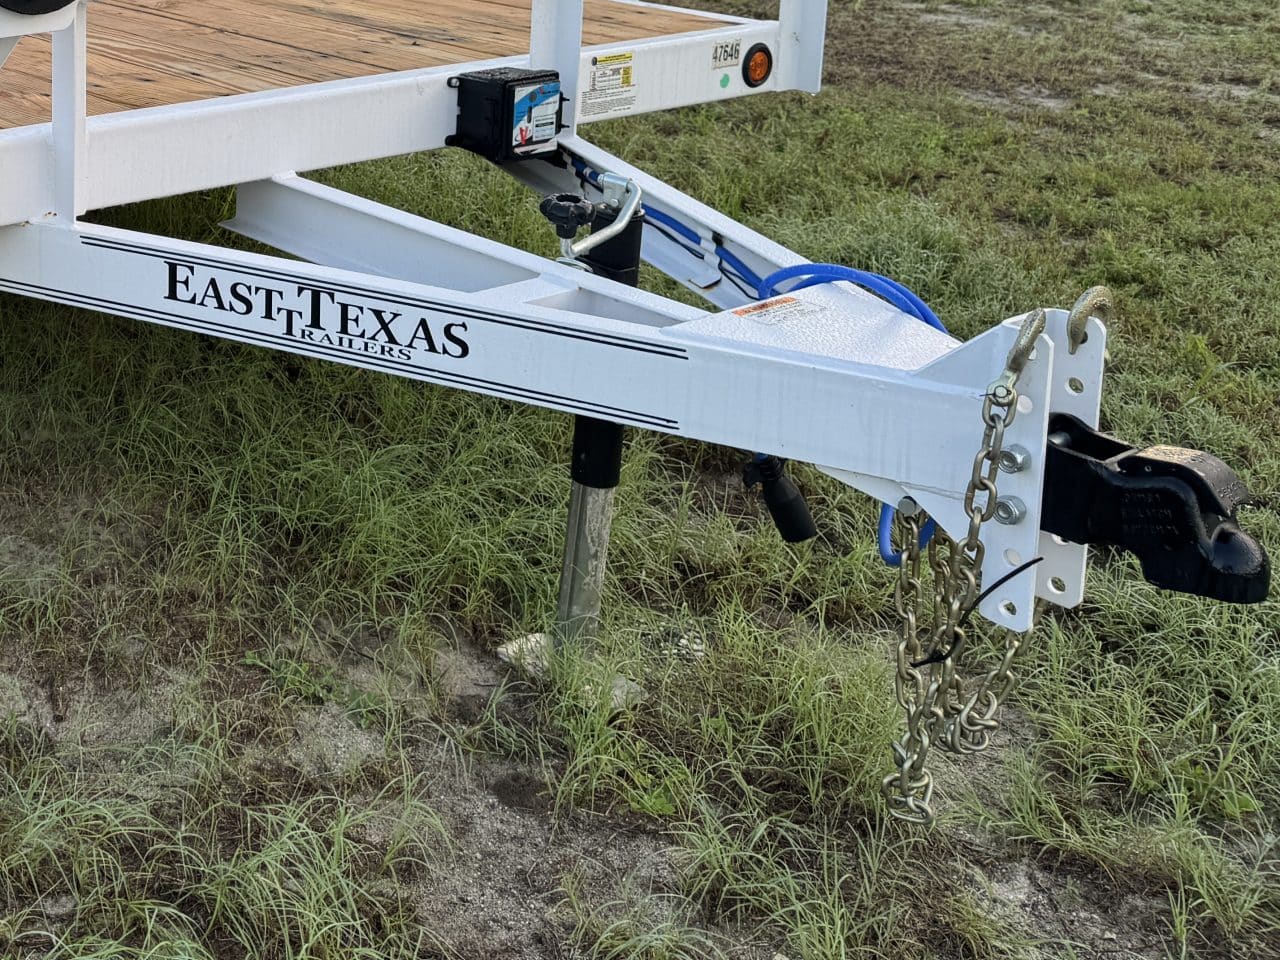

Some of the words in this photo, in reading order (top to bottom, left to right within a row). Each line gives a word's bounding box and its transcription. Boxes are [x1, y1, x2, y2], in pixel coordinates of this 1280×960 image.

[712, 42, 741, 62] 47646
[163, 259, 284, 322] EAST
[296, 284, 470, 359] TEXAS
[276, 305, 412, 361] TRAILERS
